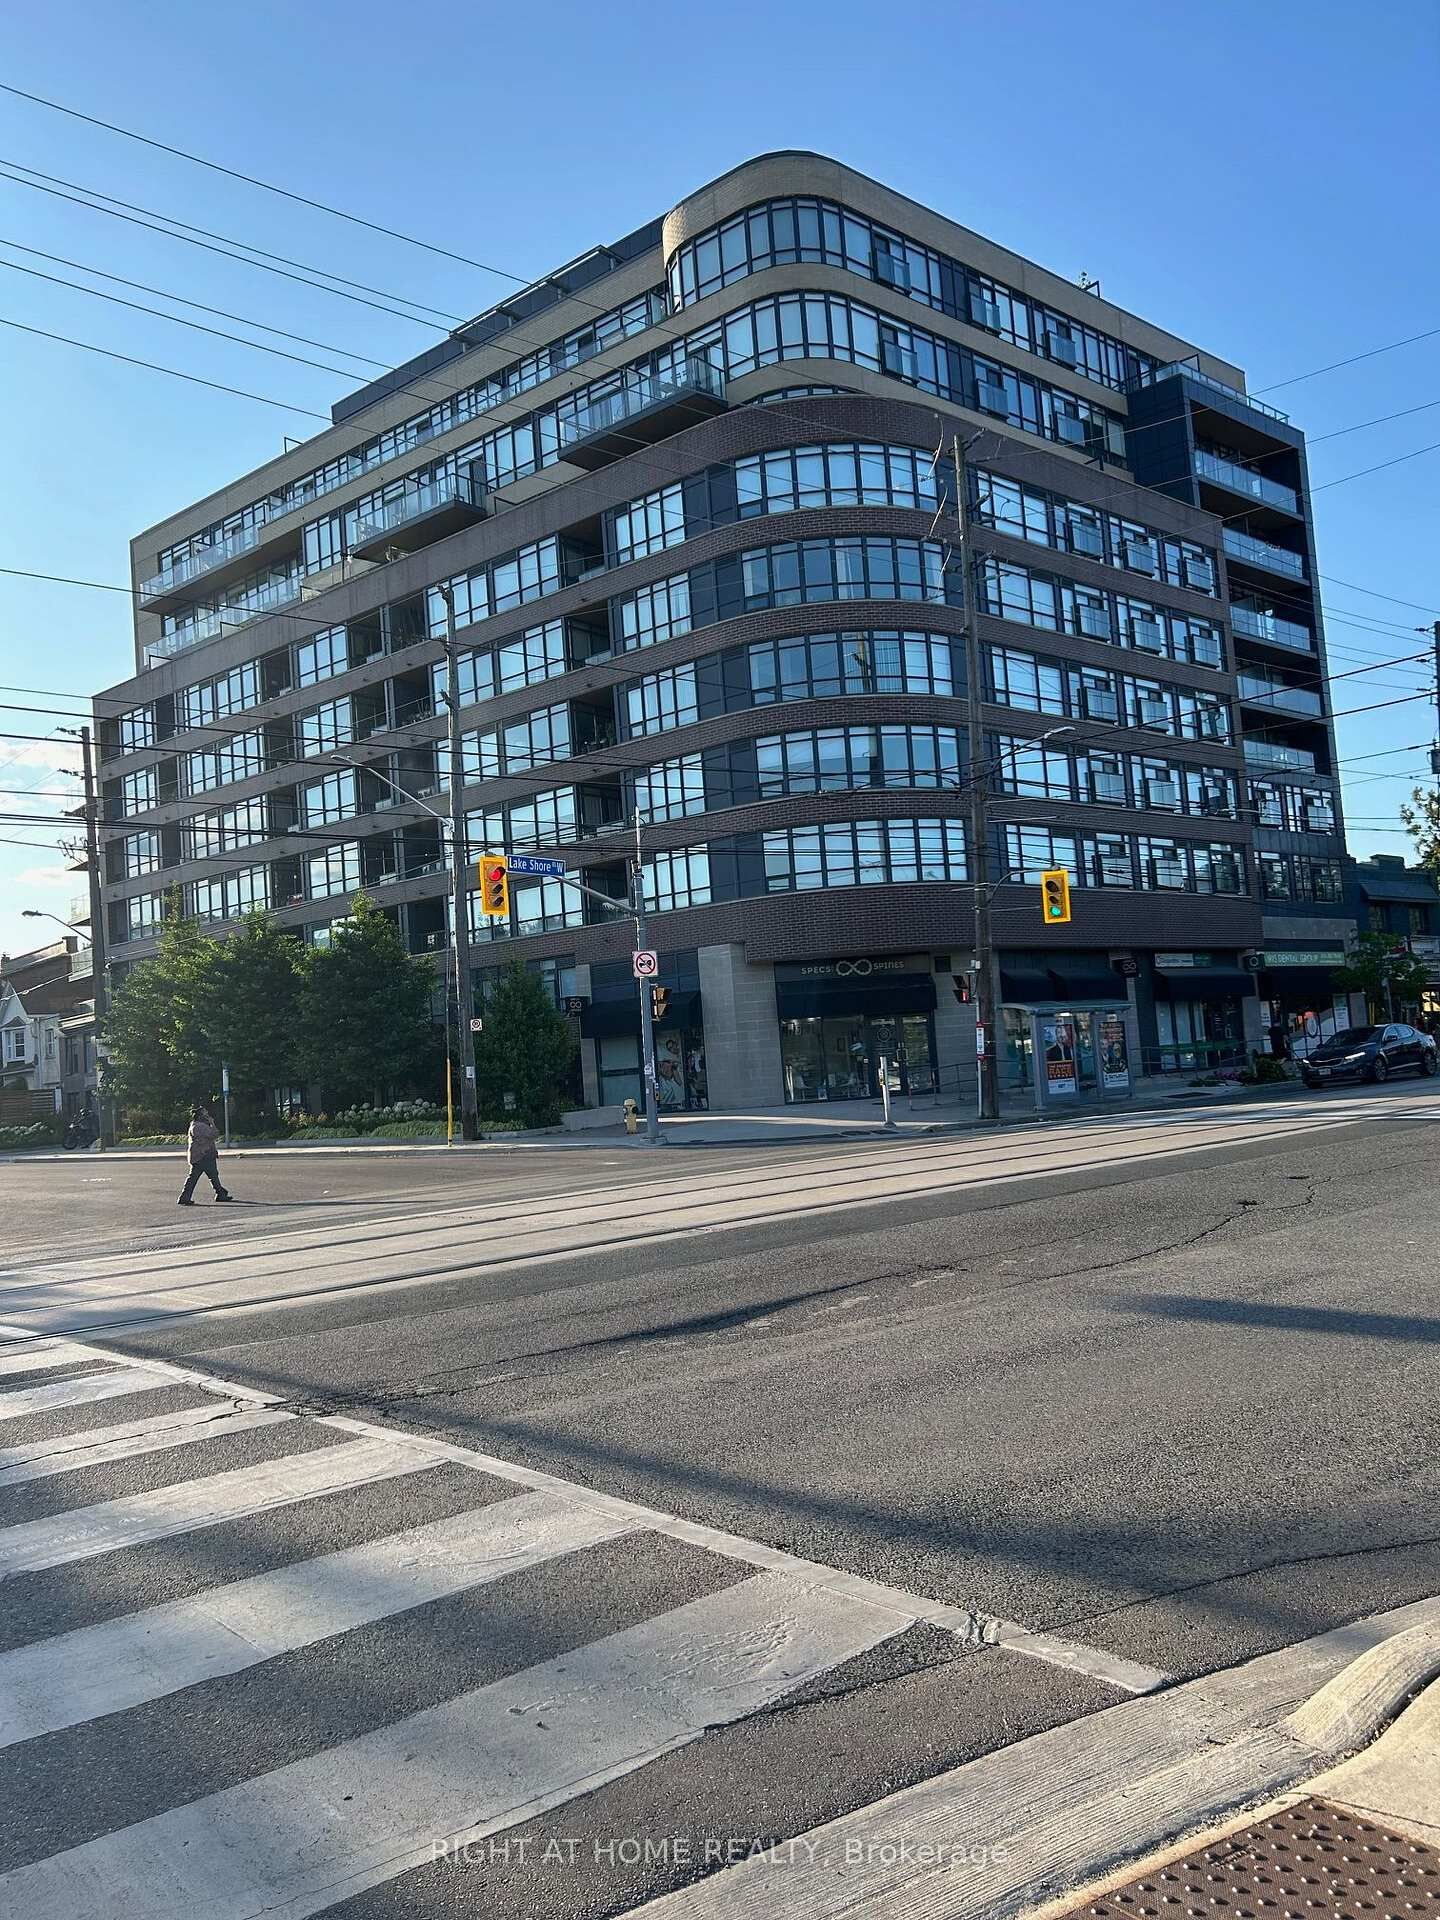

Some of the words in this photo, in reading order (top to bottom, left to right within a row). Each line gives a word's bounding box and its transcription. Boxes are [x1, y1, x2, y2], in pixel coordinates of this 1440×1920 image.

[509, 857, 527, 870] Lake
[530, 859, 552, 872] Shore
[556, 861, 564, 873] W
[801, 966, 831, 975] SPECS
